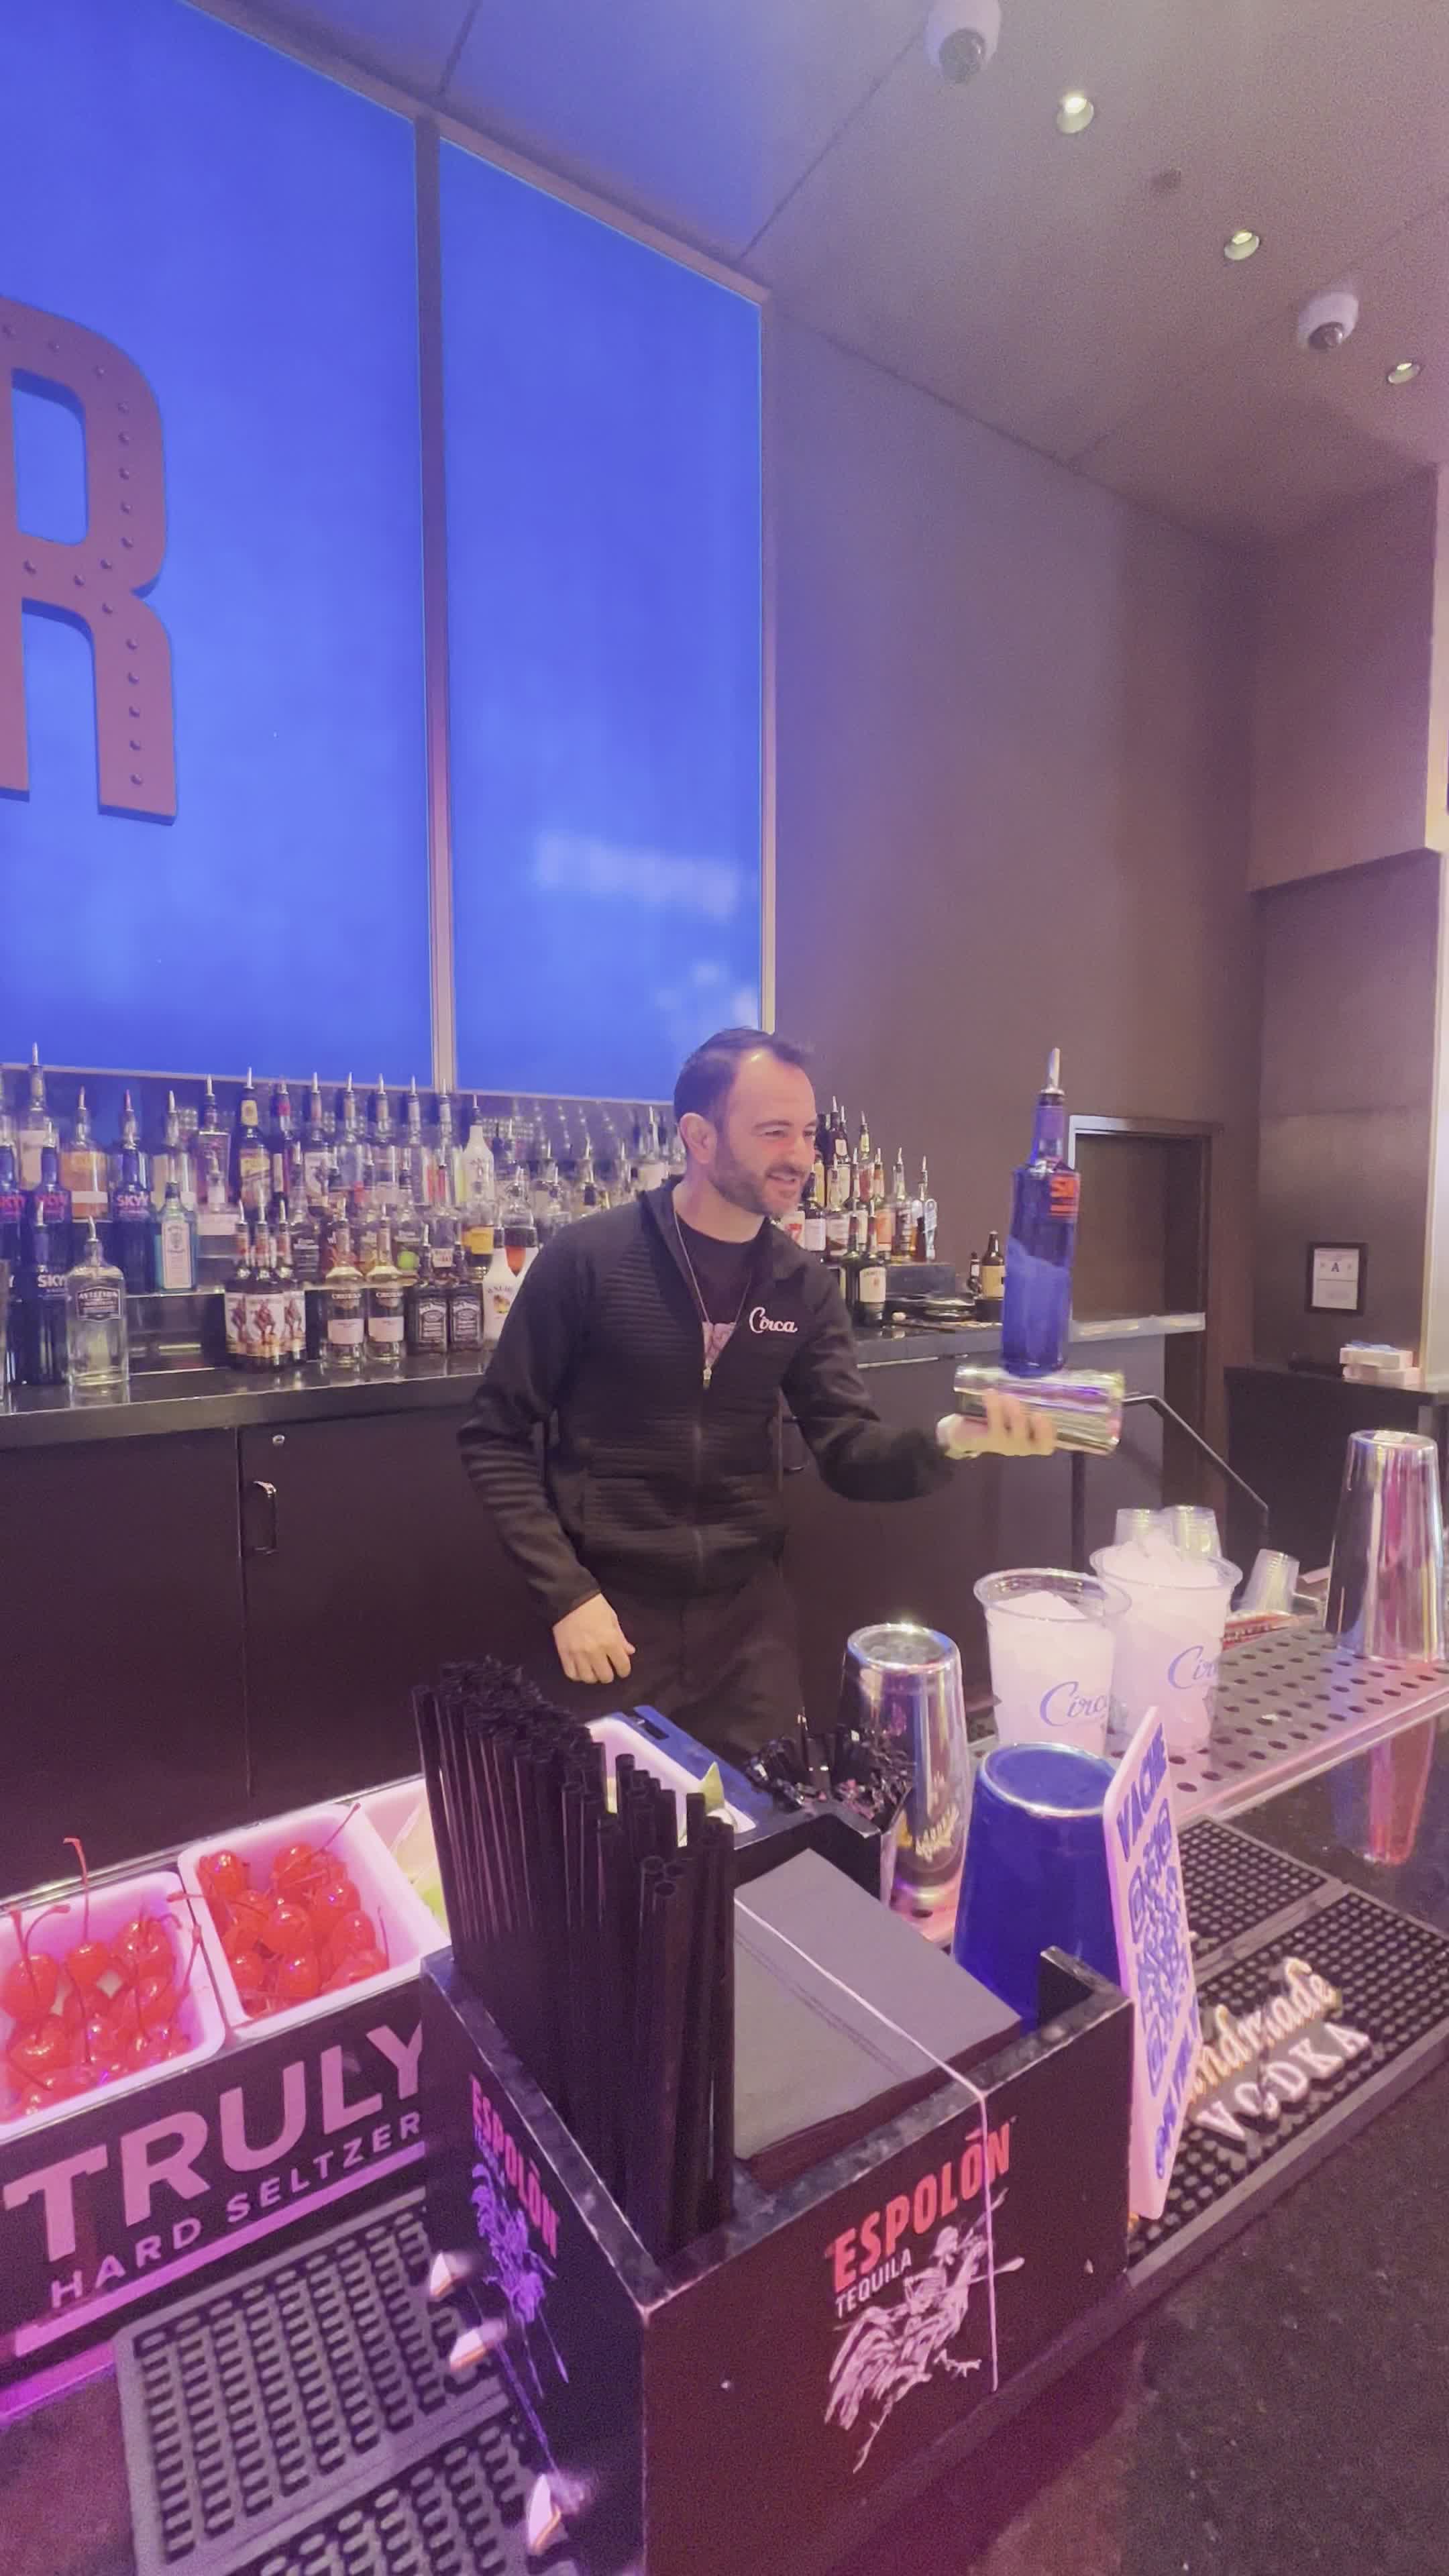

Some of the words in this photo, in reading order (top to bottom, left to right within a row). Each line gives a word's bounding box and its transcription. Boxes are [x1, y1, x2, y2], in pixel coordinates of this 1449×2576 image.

[0, 295, 176, 825] R
[117, 1193, 149, 1207] SKYY
[749, 1307, 798, 1334] Circa
[1195, 2021, 1371, 2140] VODKA
[3, 2021, 423, 2263] TRULY
[50, 2216, 202, 2309] HARD
[226, 2110, 421, 2222] SELTZER
[835, 2248, 912, 2319] TEQUILA
